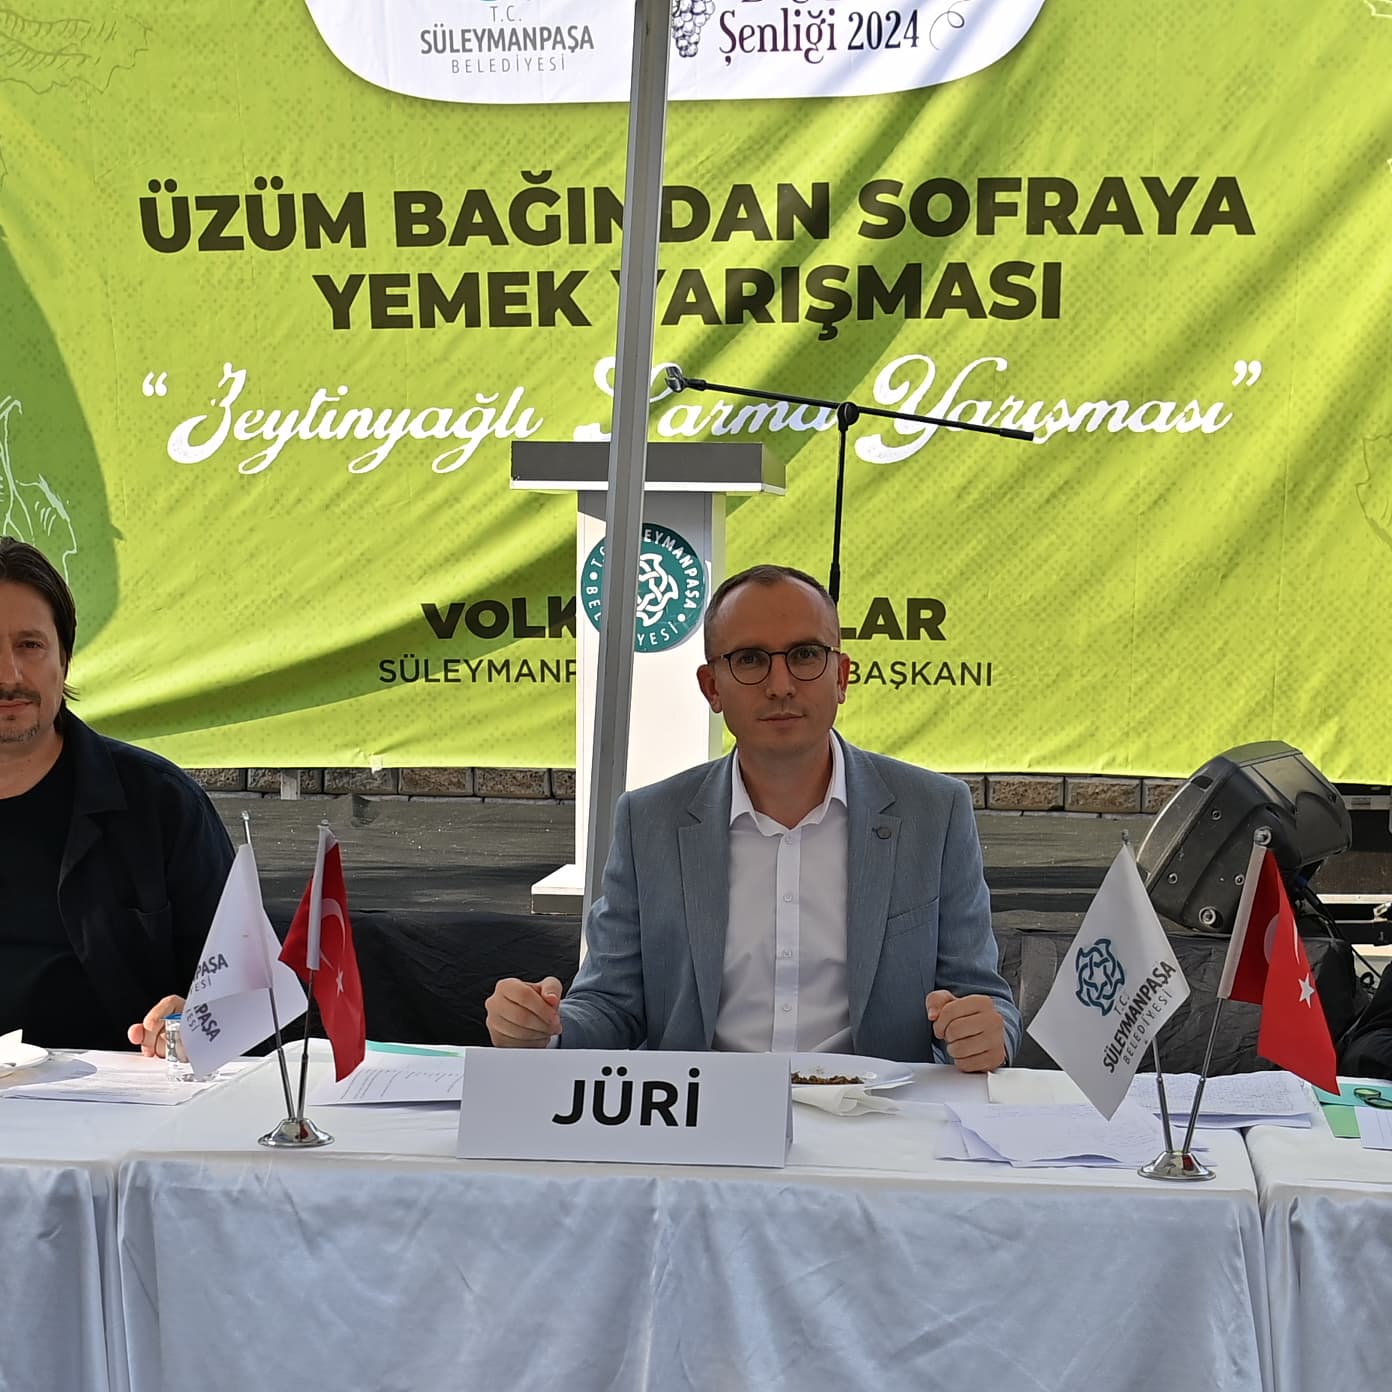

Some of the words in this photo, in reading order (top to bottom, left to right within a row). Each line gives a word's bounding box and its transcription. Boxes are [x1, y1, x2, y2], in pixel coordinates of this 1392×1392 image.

[419, 23, 595, 55] SÜLEYMANPAŞA
[489, 5, 523, 23] T.C.
[718, 7, 838, 66] Şenliği
[847, 9, 920, 50] 2024
[451, 53, 566, 74] BELEDİYESİ
[138, 175, 368, 253] ÜZÜM
[856, 176, 1256, 240] SOFRAYA
[312, 270, 593, 330] YEMEK
[1102, 961, 1177, 1074] SÜLEYMANPAŞA
[551, 1066, 701, 1127] JÜRİ
